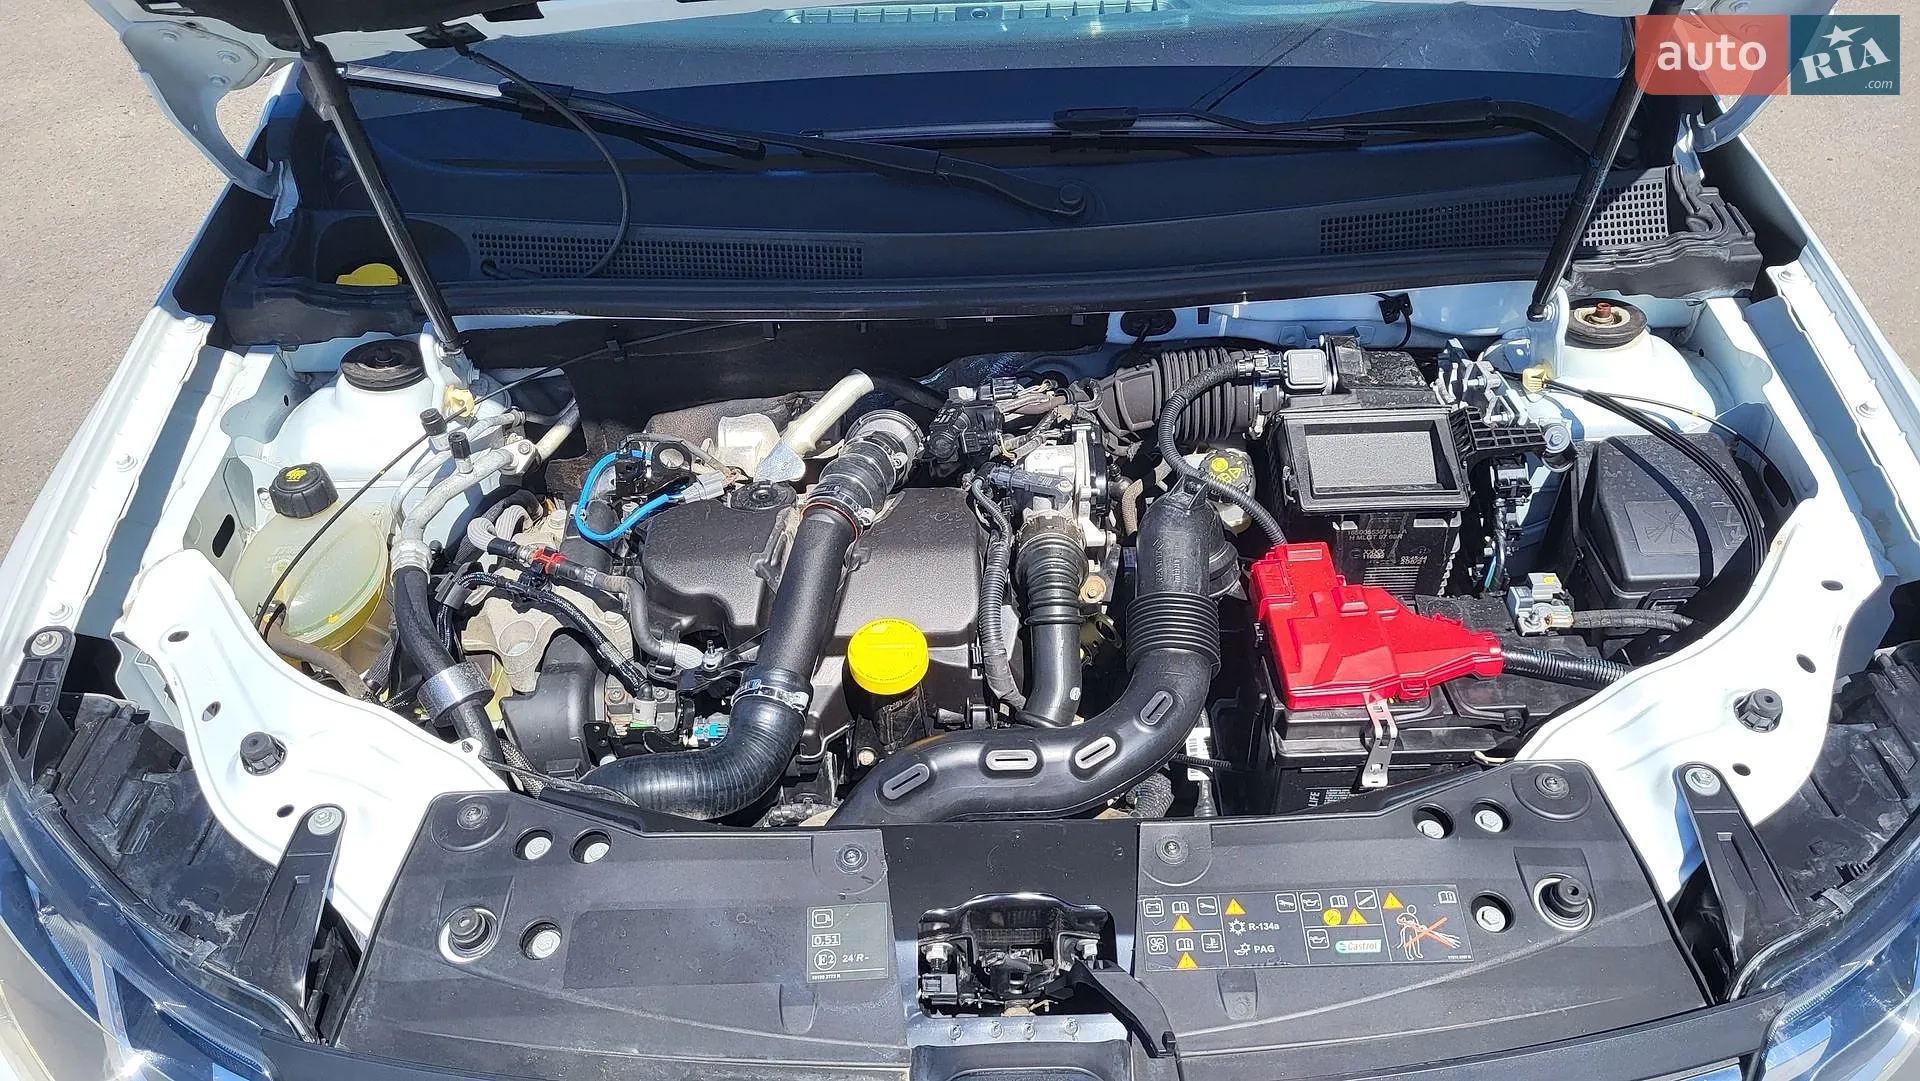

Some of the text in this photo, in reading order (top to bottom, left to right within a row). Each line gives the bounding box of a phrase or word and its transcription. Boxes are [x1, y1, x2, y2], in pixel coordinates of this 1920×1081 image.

[1308, 791, 1321, 807] LIFE
[1248, 920, 1280, 932] R-134a
[1253, 944, 1276, 954] PAG
[1347, 941, 1377, 952] Castrol
[842, 955, 854, 963] 24
